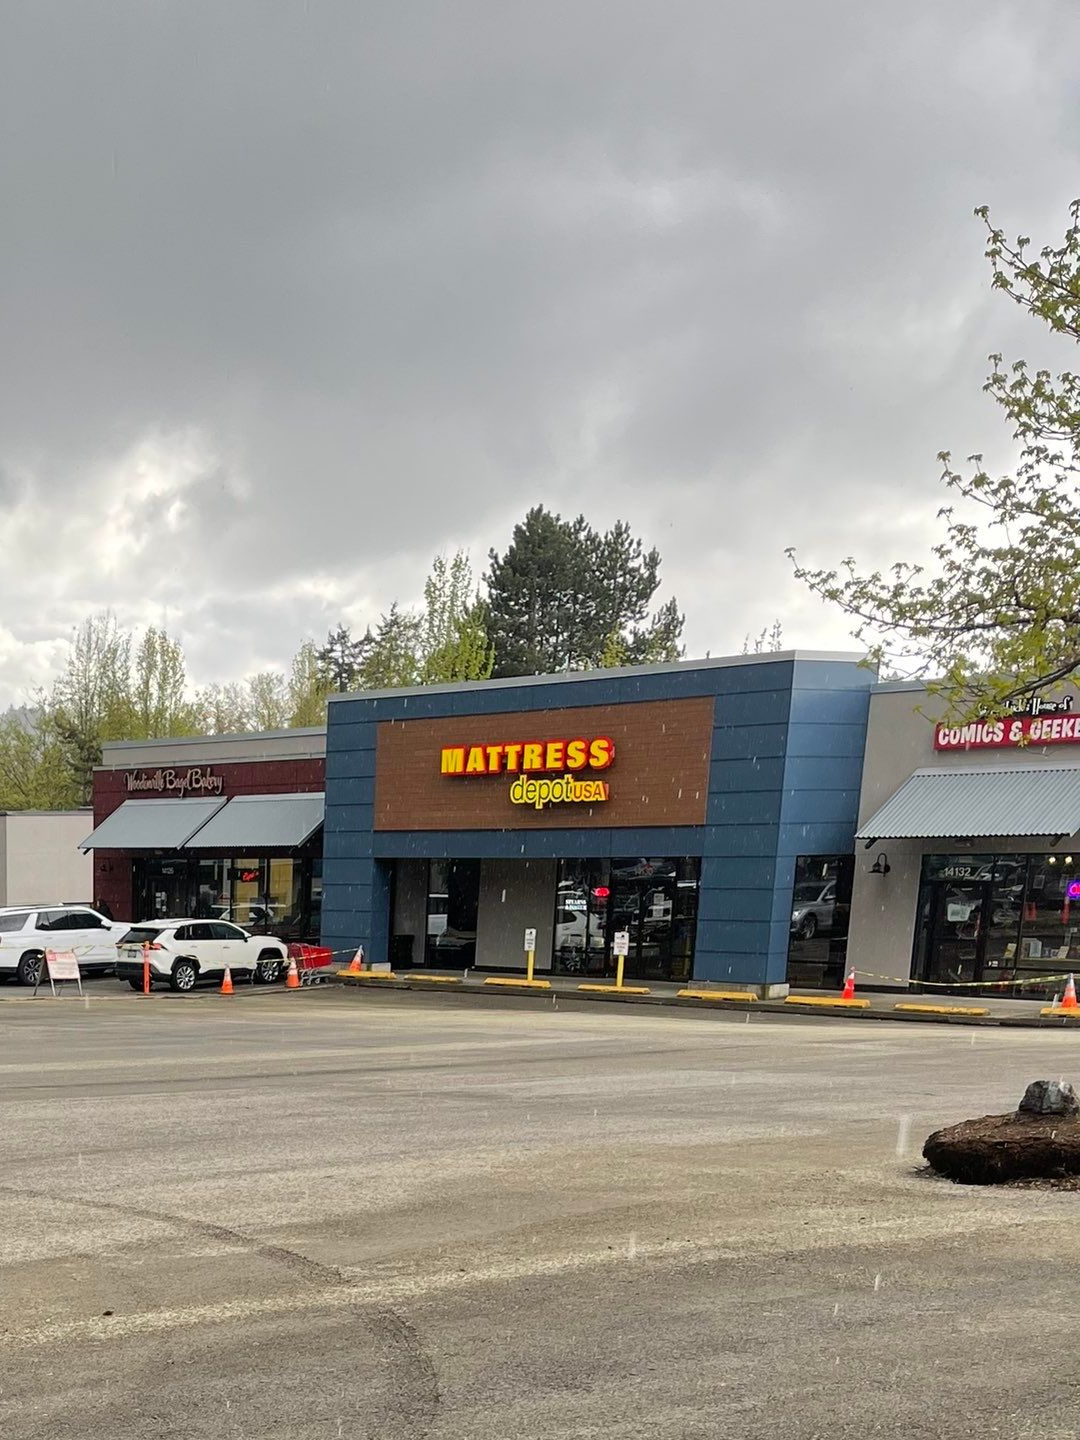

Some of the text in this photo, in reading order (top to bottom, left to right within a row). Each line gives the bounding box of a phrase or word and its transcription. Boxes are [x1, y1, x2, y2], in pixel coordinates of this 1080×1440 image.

[1058, 696, 1072, 711] of
[938, 722, 1004, 745] COMICS
[1009, 720, 1023, 742] &
[440, 736, 614, 776] MATTRESS
[123, 767, 223, 797] Woodinville Bagel Bakery
[943, 866, 972, 877] 14132
